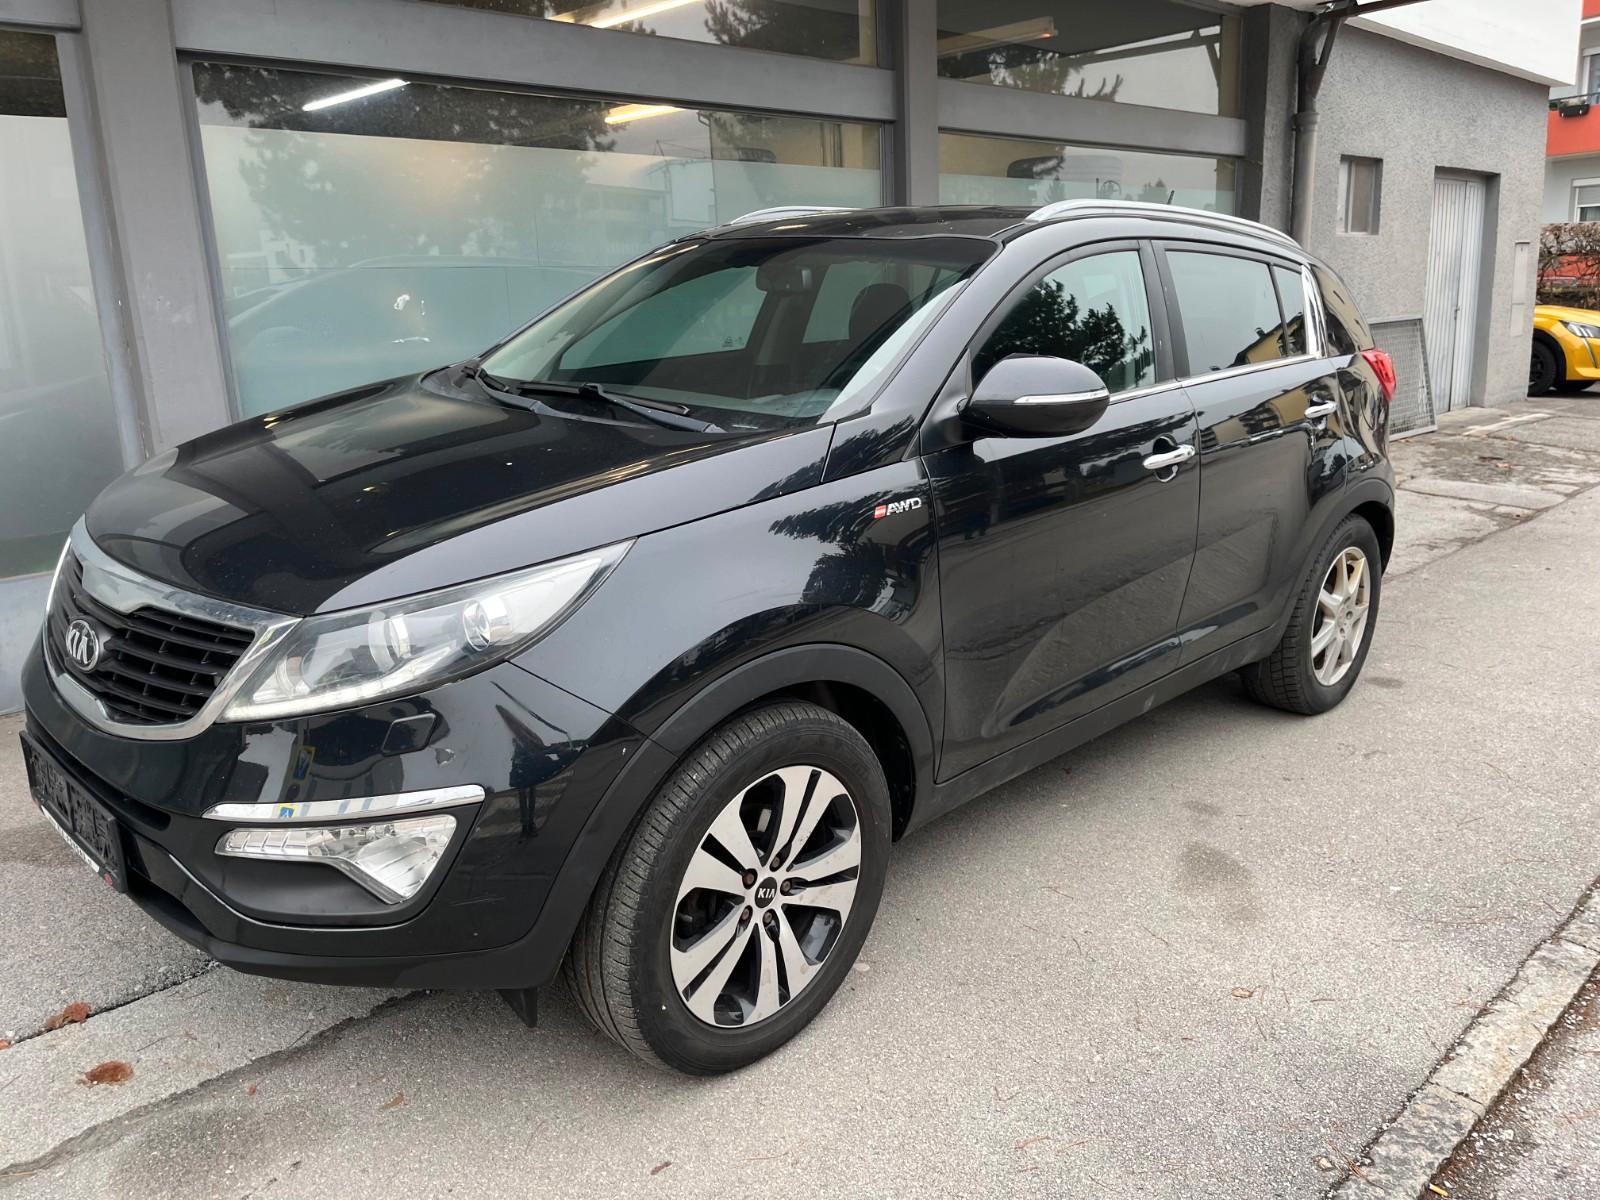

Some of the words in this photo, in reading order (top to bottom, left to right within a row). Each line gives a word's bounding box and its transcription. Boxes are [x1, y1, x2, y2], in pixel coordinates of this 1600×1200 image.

[886, 497, 922, 515] AWD
[68, 629, 88, 664] KIA
[757, 888, 776, 899] KIA
